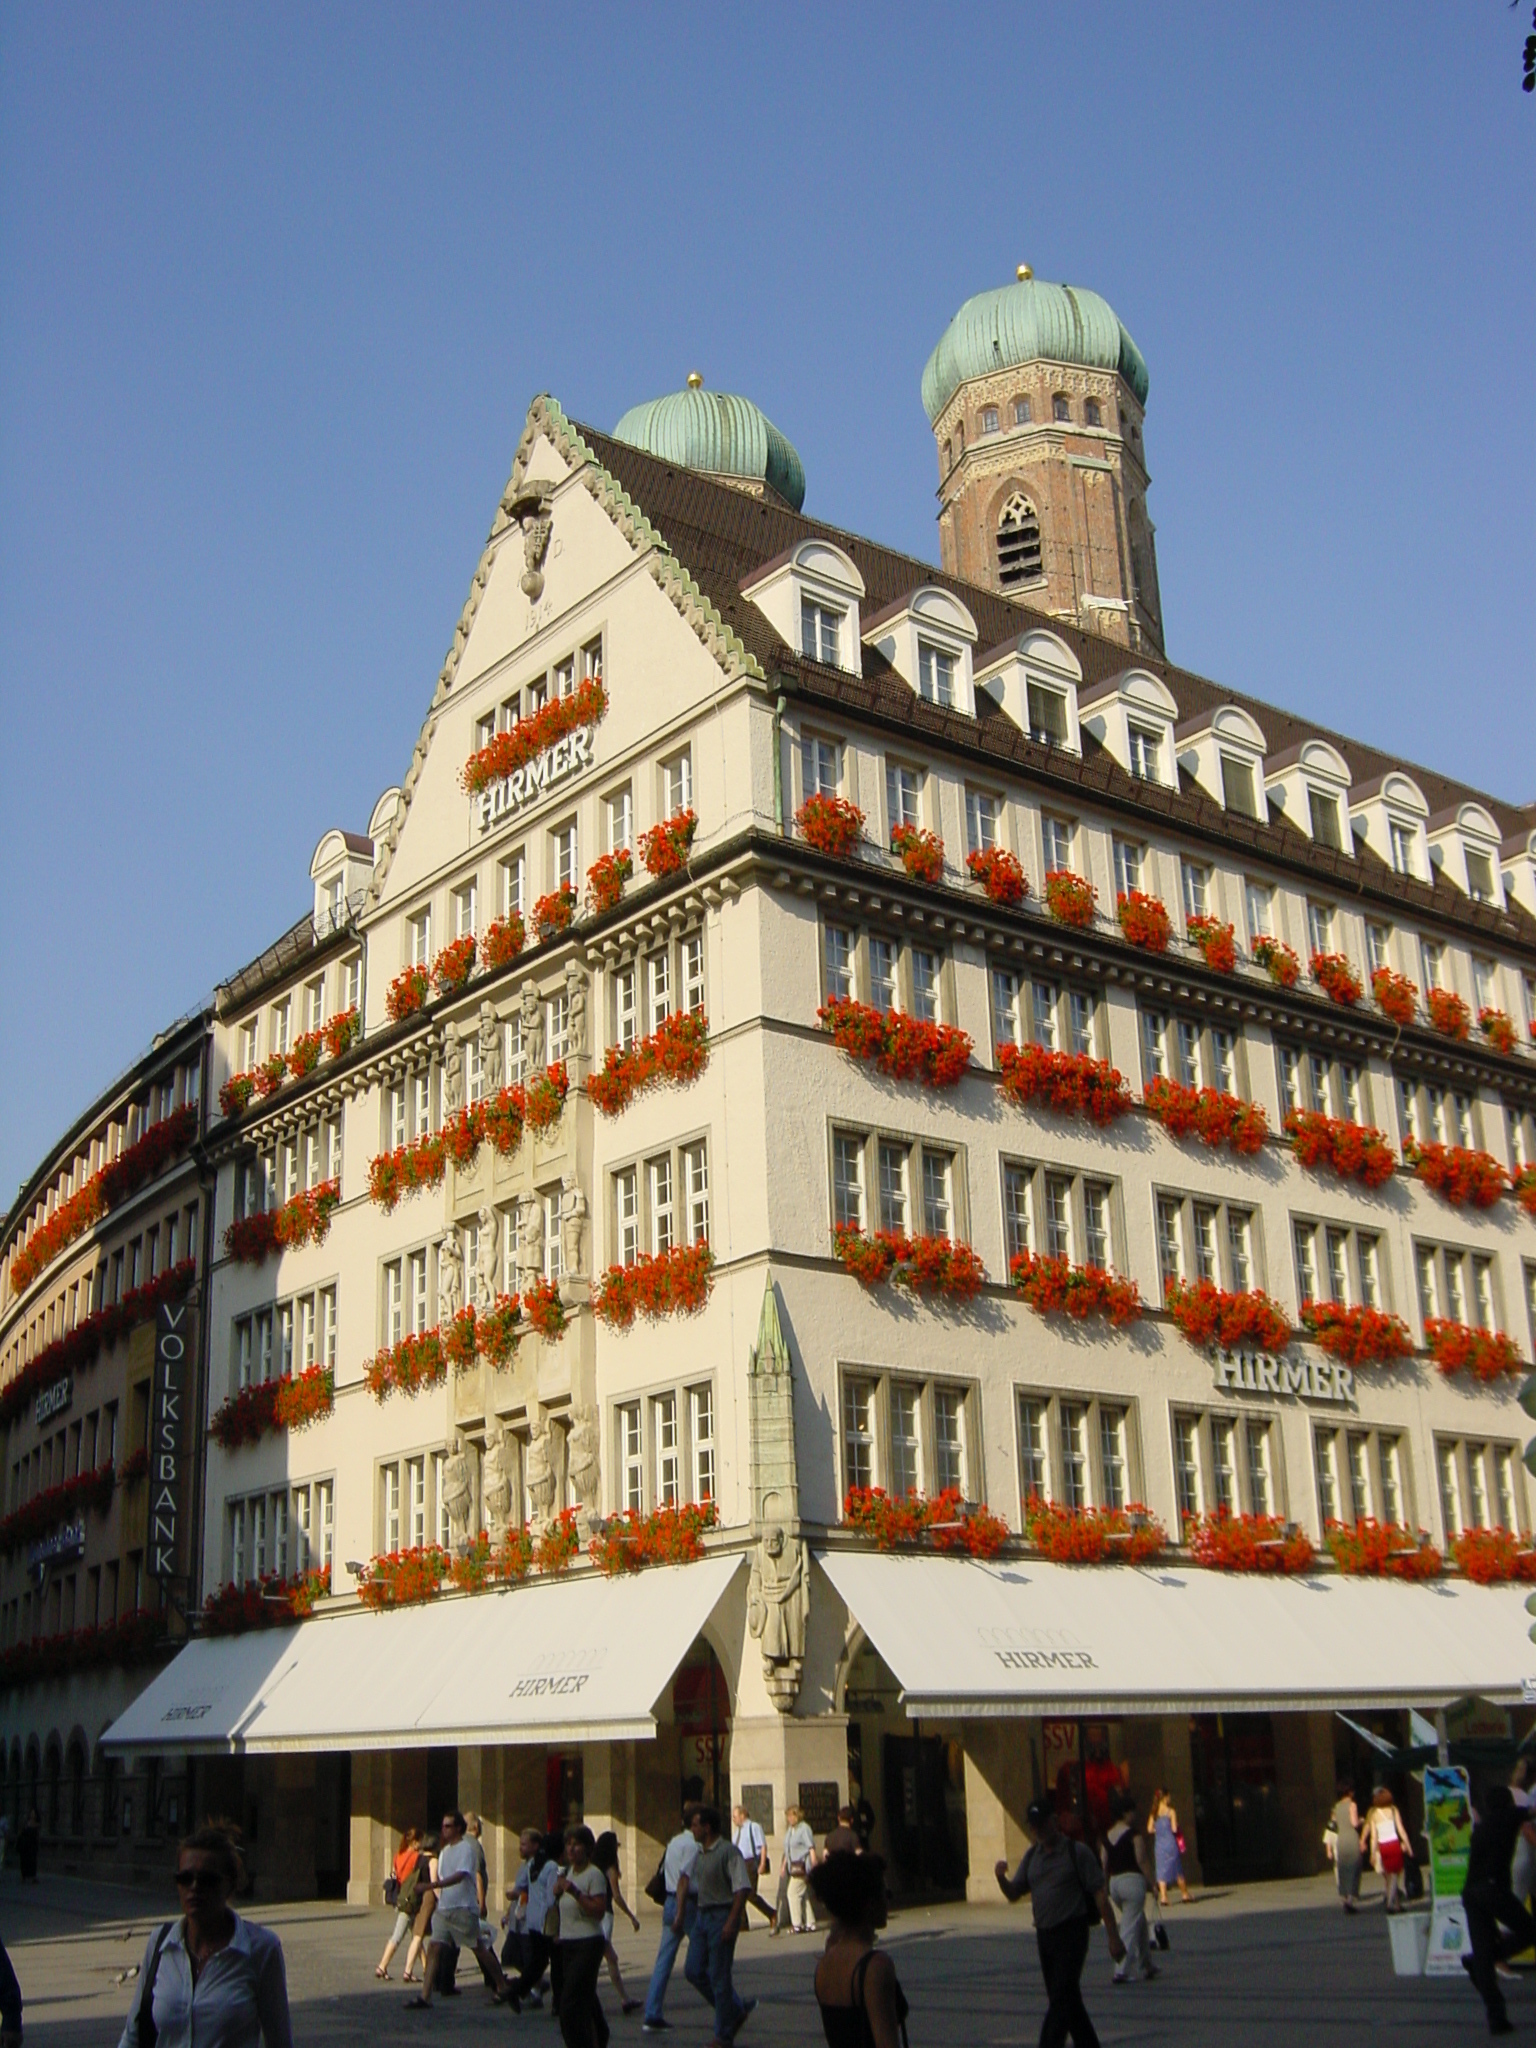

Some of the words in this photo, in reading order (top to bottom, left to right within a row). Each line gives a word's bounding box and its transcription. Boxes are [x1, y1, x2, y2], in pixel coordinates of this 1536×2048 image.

[476, 726, 591, 830] HIRMER
[1214, 1348, 1356, 1402] HIRMER
[154, 1303, 186, 1574] VOLKSBANK
[993, 1651, 1099, 1669] HIRMER
[508, 1674, 590, 1698] HIRMER
[1043, 1724, 1075, 1750] SSV
